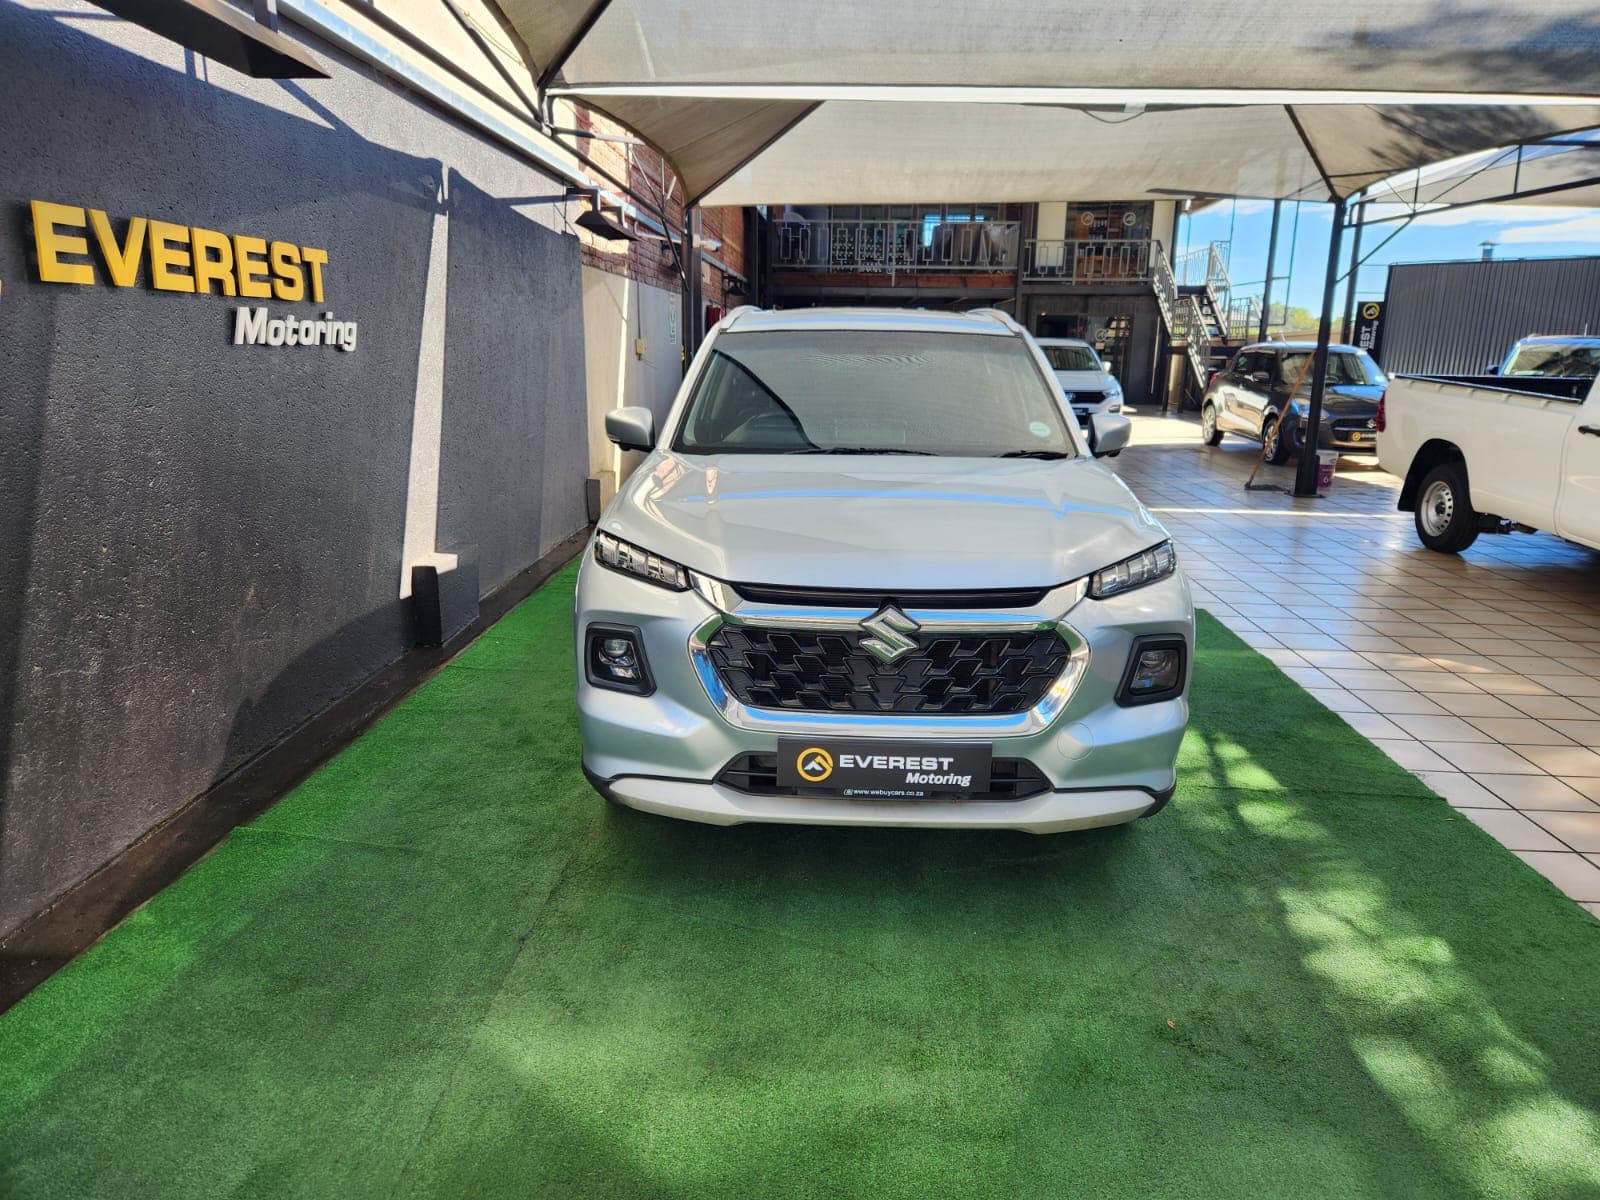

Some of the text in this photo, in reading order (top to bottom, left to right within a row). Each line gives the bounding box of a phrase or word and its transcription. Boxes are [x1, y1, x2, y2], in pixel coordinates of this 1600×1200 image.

[30, 200, 328, 302] EVEREST
[234, 307, 358, 351] Motoring
[1359, 325, 1371, 350] EST
[839, 754, 954, 770] EVEREST
[905, 773, 972, 787] Motoring
[853, 788, 924, 797] www.webuycars.co.za
